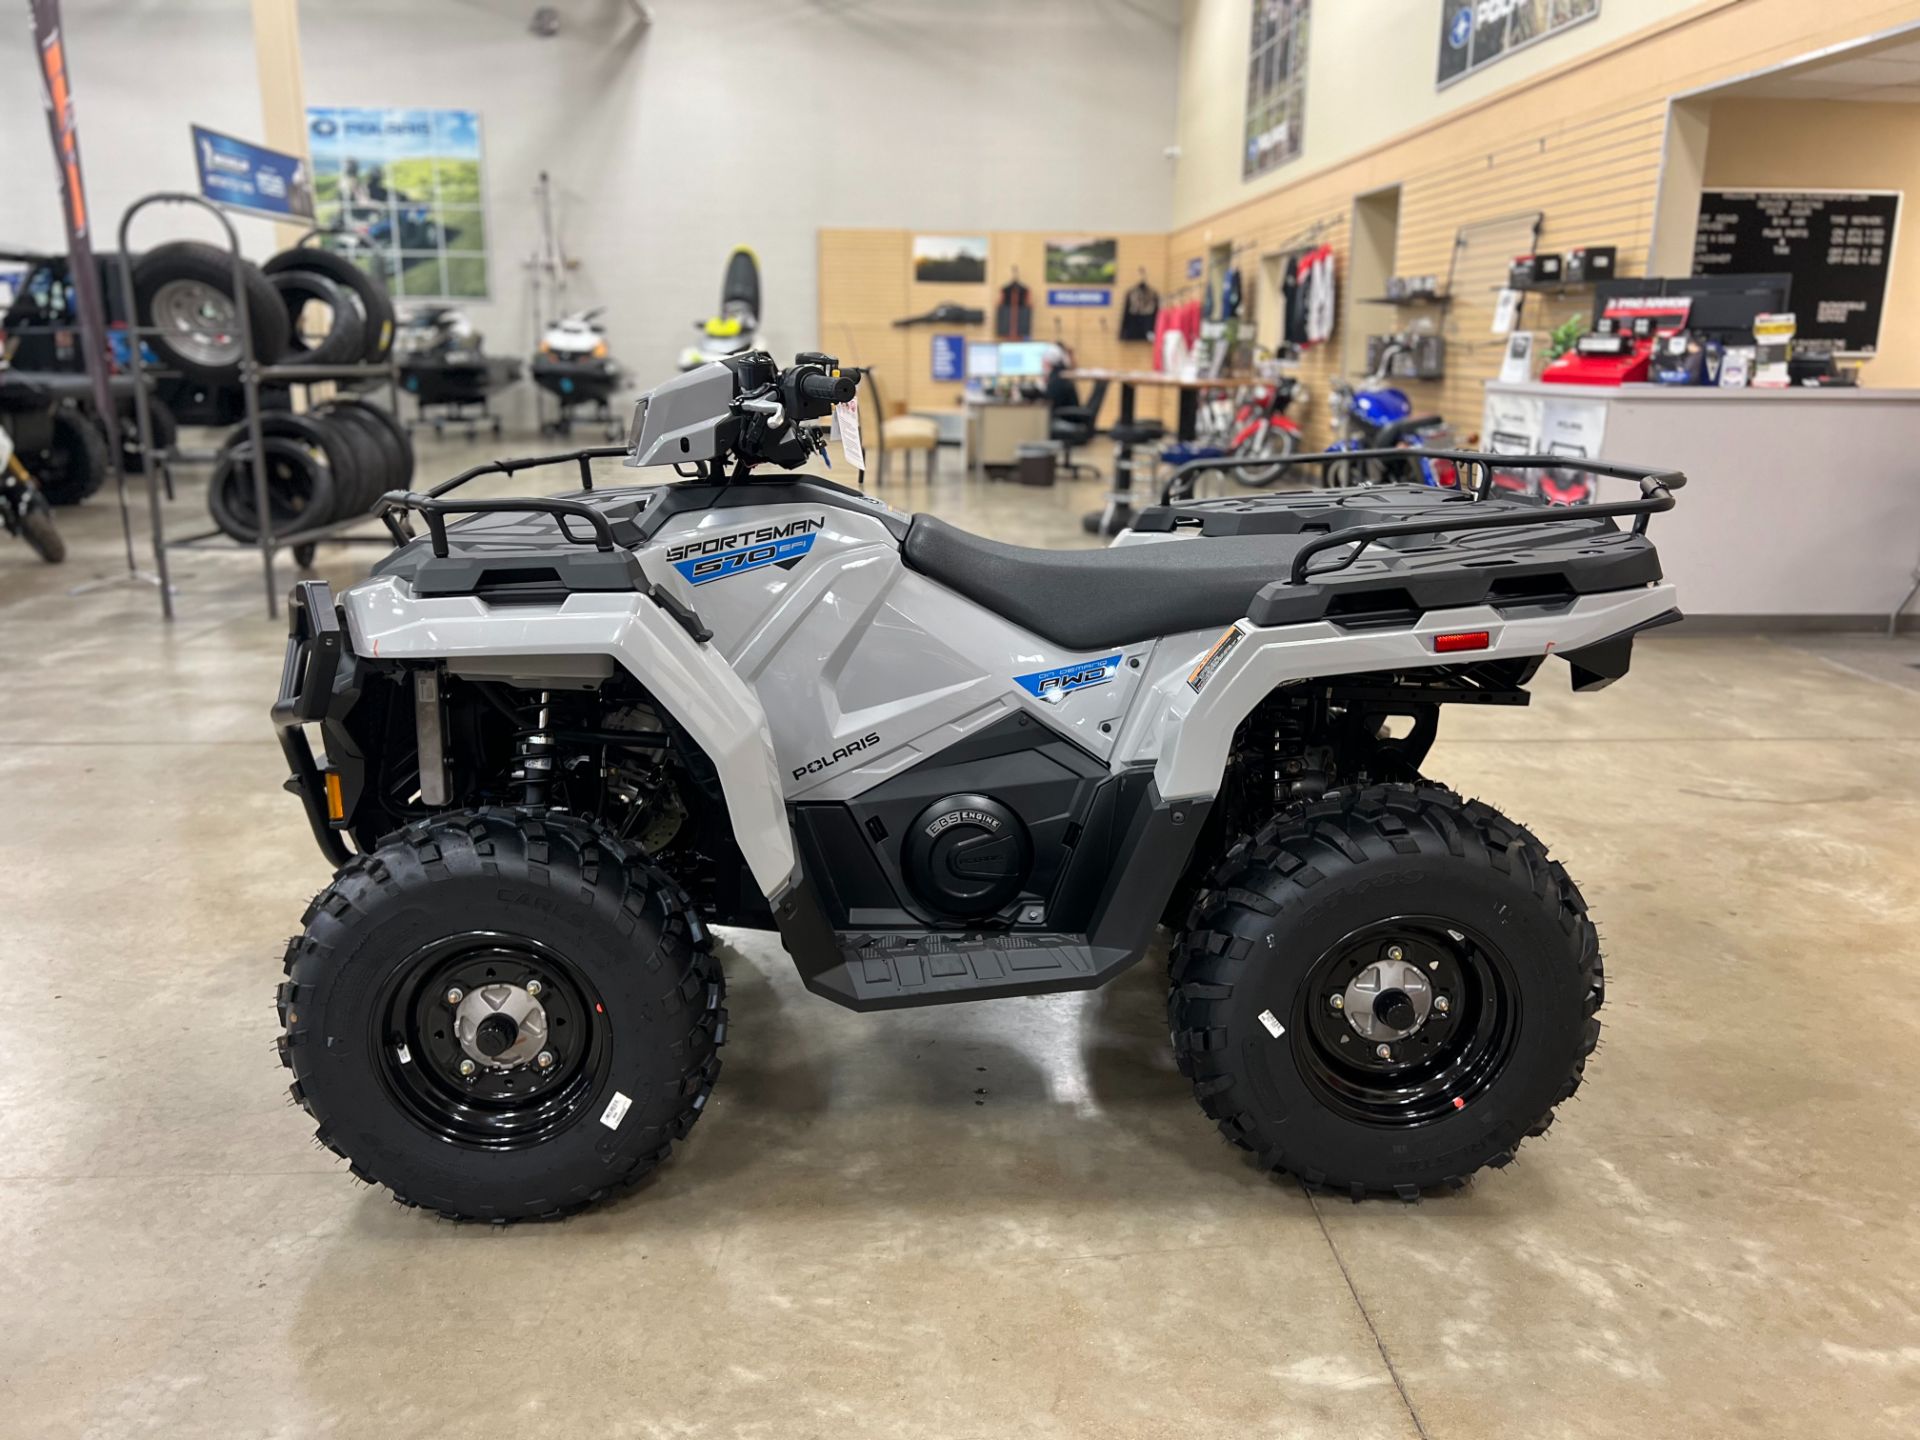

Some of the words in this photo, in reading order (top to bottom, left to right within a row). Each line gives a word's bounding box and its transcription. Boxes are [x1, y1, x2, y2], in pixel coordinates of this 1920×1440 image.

[666, 516, 825, 562] SPORTSMAN
[693, 545, 777, 578] 570
[778, 540, 807, 553] EFI
[1038, 667, 1106, 693] AWD
[792, 732, 881, 781] POLARIS
[928, 812, 960, 836] EBS
[961, 811, 1000, 828] ENGINE
